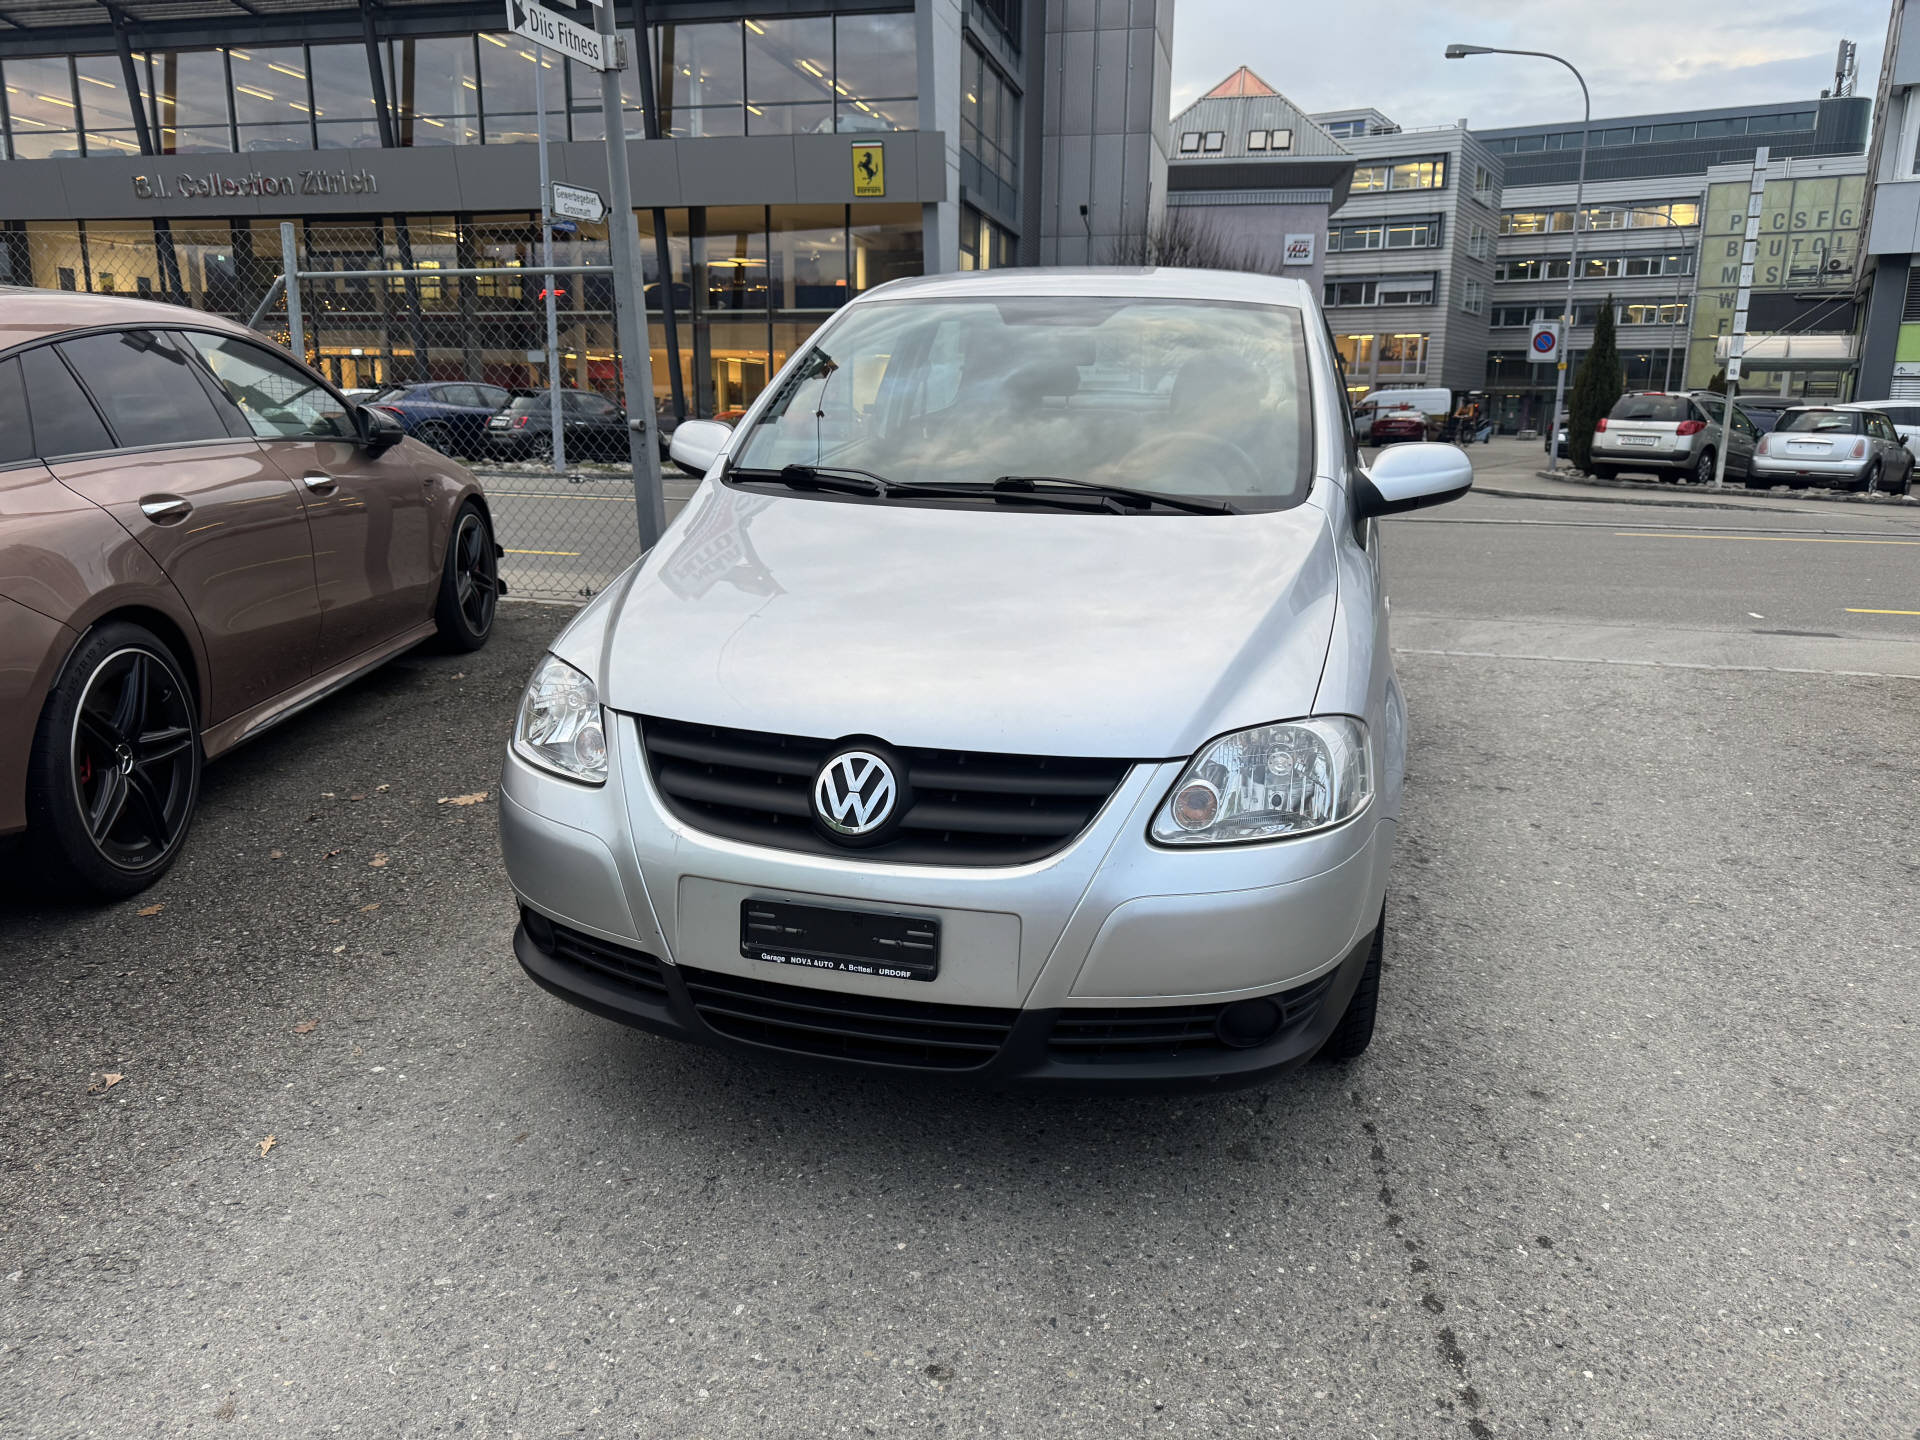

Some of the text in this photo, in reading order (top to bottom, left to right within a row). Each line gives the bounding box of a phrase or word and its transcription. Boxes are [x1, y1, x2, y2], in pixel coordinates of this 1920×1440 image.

[529, 8, 599, 60] Diis Fitness
[177, 172, 296, 198] Collection
[299, 168, 378, 196] Zürich
[761, 952, 786, 963] Garage
[790, 956, 812, 966] NOVA
[813, 959, 834, 969] AUTO
[839, 963, 847, 971] A.
[879, 968, 912, 978] URDORF
